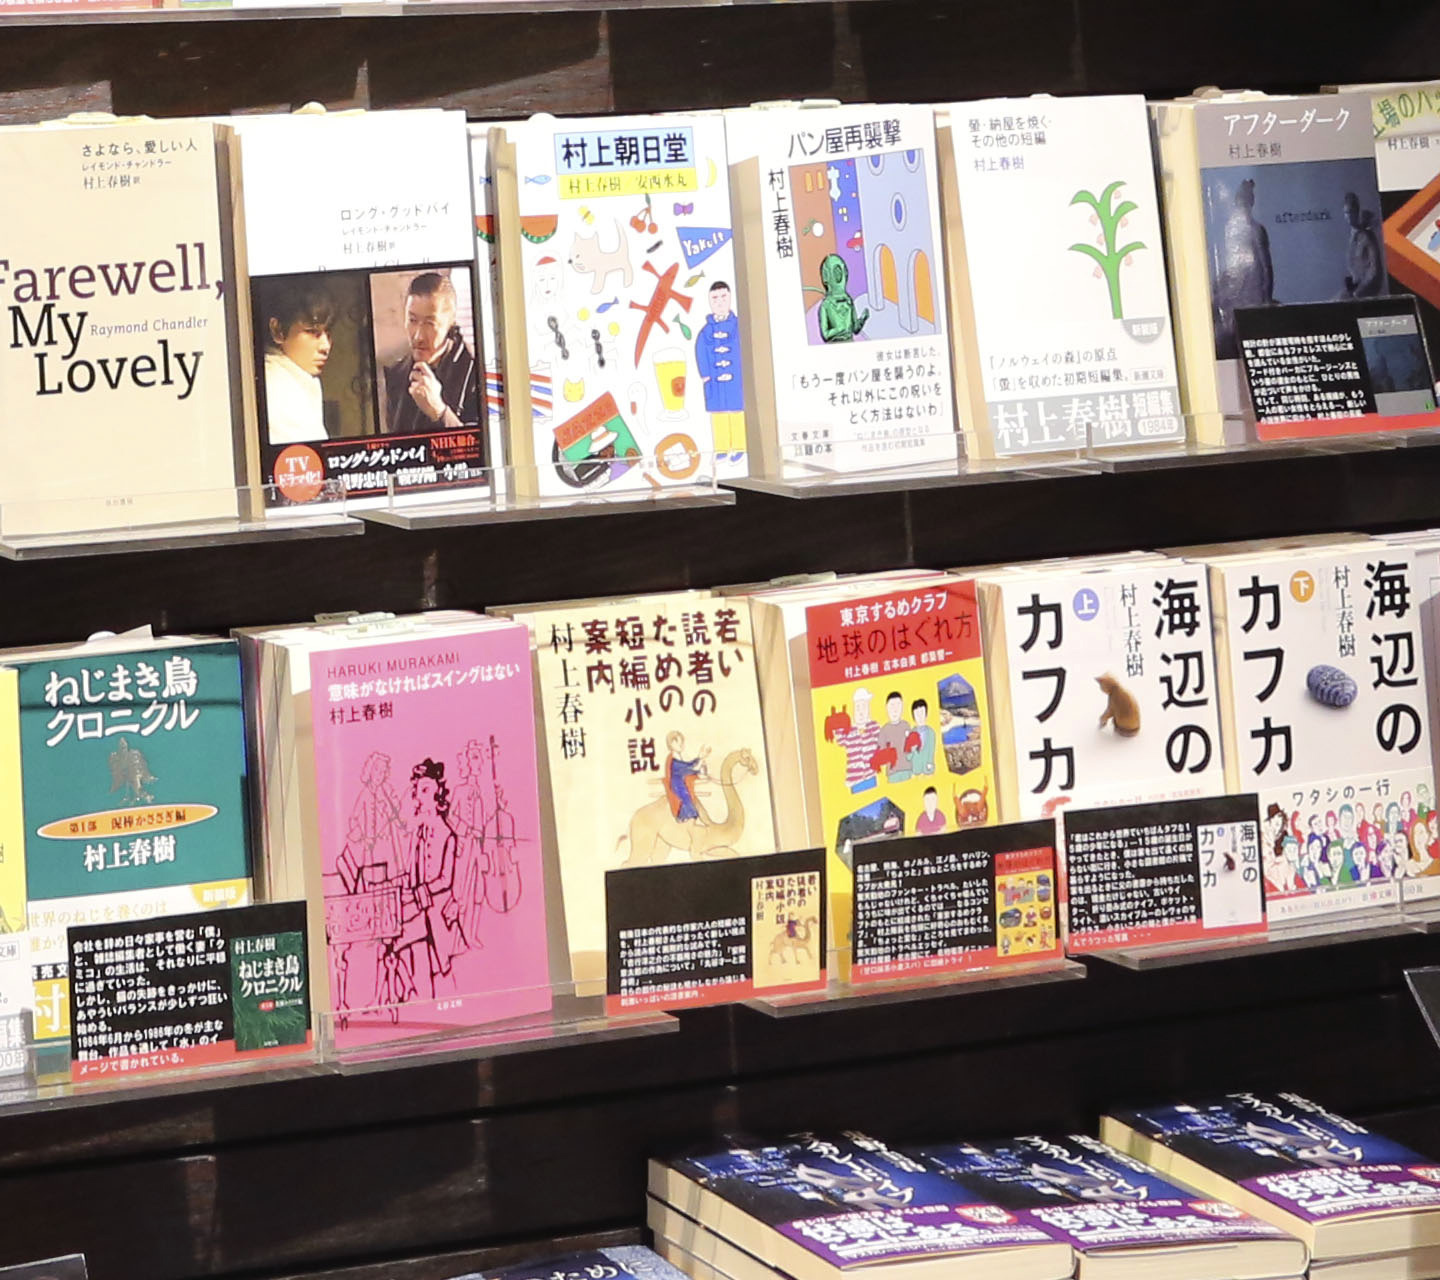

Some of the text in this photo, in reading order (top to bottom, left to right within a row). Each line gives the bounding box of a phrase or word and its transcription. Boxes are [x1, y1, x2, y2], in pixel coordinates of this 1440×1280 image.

[787, 118, 903, 159] パン屋再襲撃
[970, 130, 1048, 148] その他の短編
[1223, 106, 1352, 137] アフターダーク
[81, 139, 198, 158] さよなら、愛しい人
[81, 157, 173, 173] レイモンド・チャンドラー
[561, 131, 689, 170] 村上朝日堂
[973, 155, 1025, 172] 村上春樹
[1228, 141, 1282, 159] 村上春樹
[339, 201, 450, 223] ロング・グッドバイ
[768, 168, 794, 260] 村上春樹
[8, 301, 90, 360] My
[89, 315, 209, 338] Raymond Chandler
[35, 338, 205, 400] Lovely
[1140, 417, 1177, 434] 1984年
[285, 455, 311, 473] TV
[1077, 592, 1097, 617] 上
[1292, 577, 1312, 597] 下
[839, 592, 950, 627] 東京するめクラブ
[1332, 565, 1357, 658] 村上春樹
[714, 608, 744, 679] 若い
[816, 611, 974, 665] 地球のはぐれ方
[1119, 583, 1145, 678] 村上春樹
[326, 651, 461, 679] HARUKI MURAKAMI
[581, 619, 616, 695] 案内
[652, 614, 685, 713] ための
[681, 611, 717, 717] 読者の
[844, 663, 880, 679] 村上春樹
[1151, 577, 1213, 776] 海辺の
[1238, 574, 1293, 777] カフカ
[1362, 559, 1423, 756] 海辺の
[44, 655, 200, 708] ねじまき鳥
[327, 660, 520, 703] 意味がなければスイングはない
[547, 622, 587, 760] 村上春樹
[614, 616, 661, 775] 短編小説
[1017, 592, 1076, 795] カフカ
[45, 696, 201, 748] クロニクル
[328, 701, 394, 726] 村上春樹
[1292, 778, 1392, 807] ワタシの一行
[82, 835, 177, 873] 村上春樹
